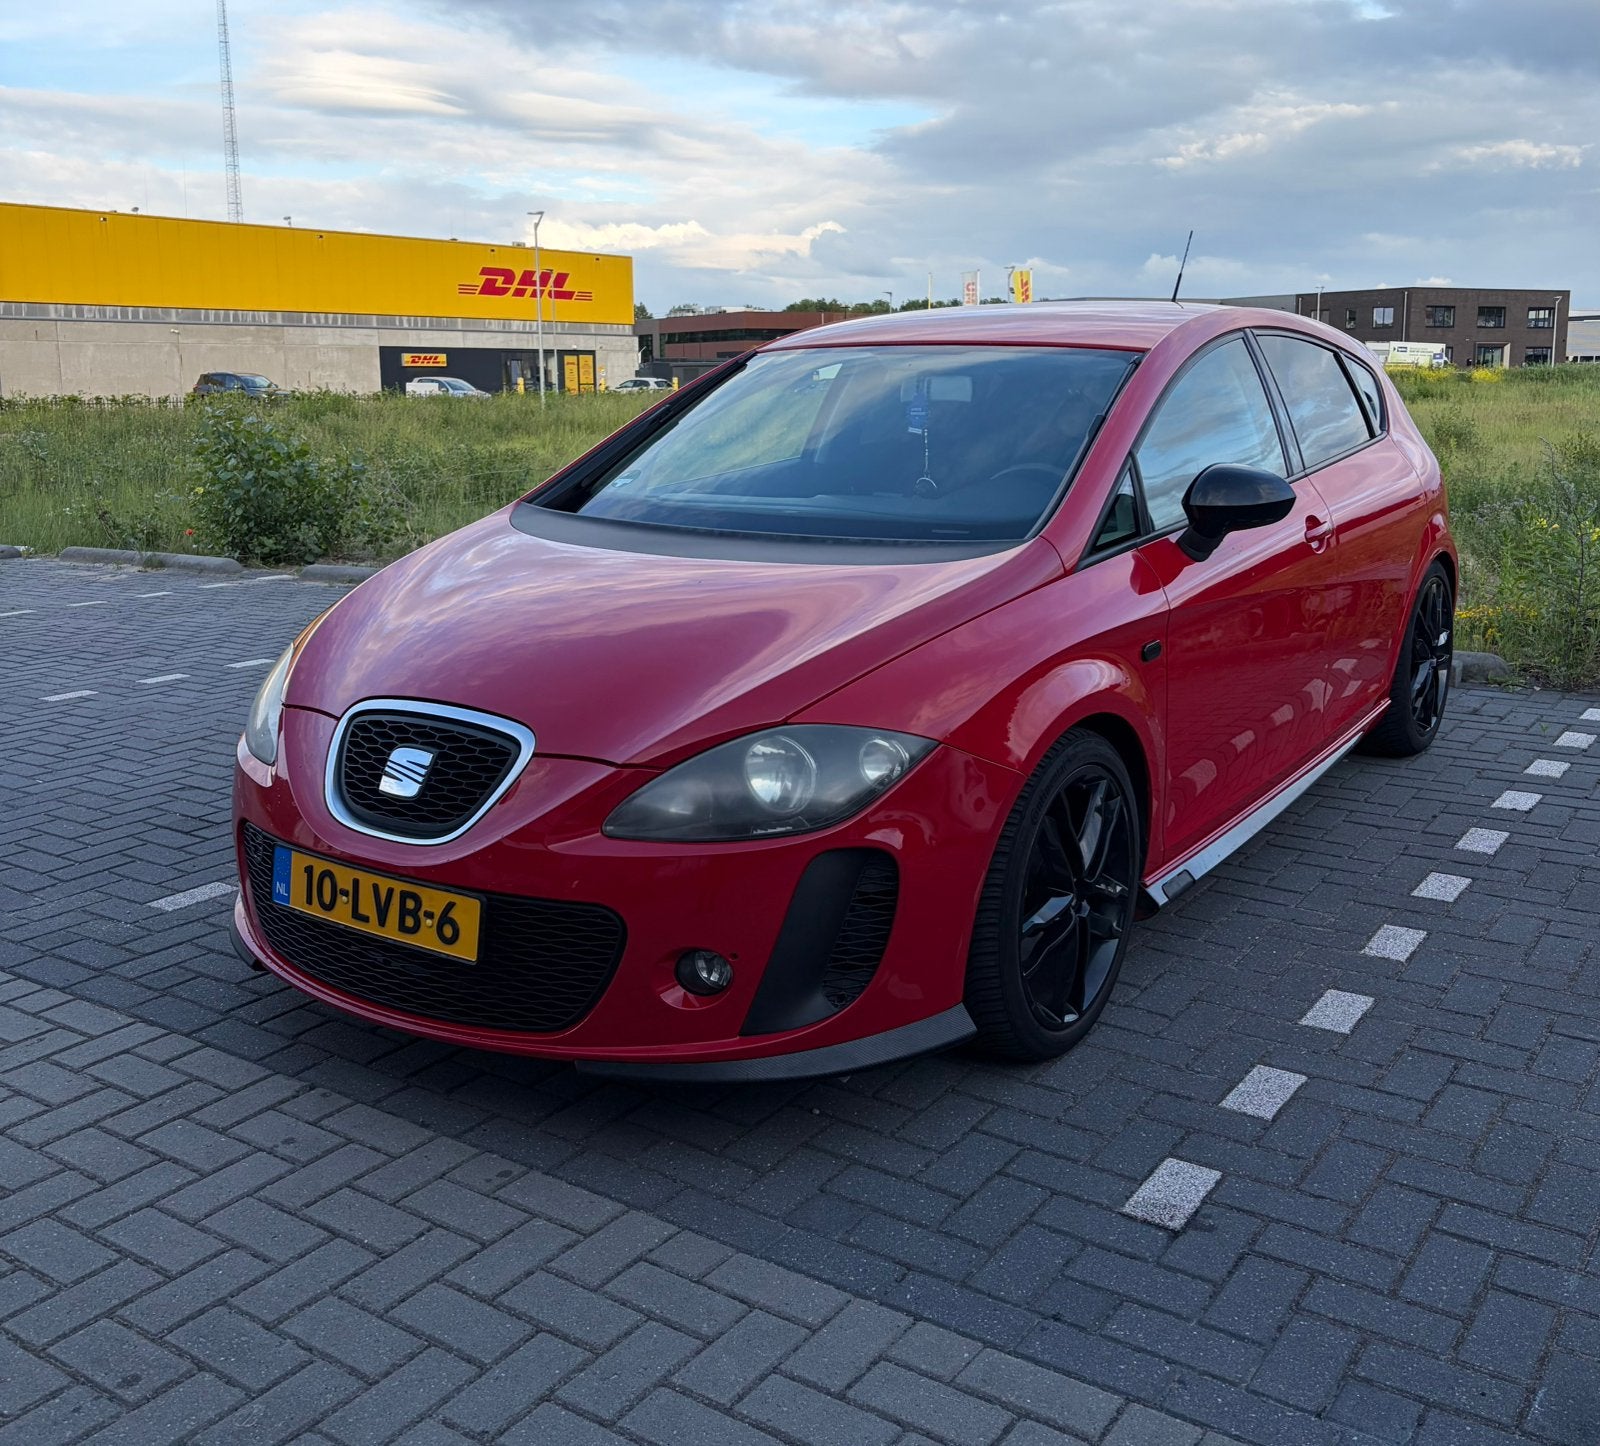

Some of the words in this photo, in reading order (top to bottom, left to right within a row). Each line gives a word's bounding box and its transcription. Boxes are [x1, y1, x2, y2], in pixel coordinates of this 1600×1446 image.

[478, 267, 575, 300] DHL
[410, 355, 440, 364] DHL
[276, 881, 288, 896] NL
[304, 864, 460, 945] 10-LVB-6
